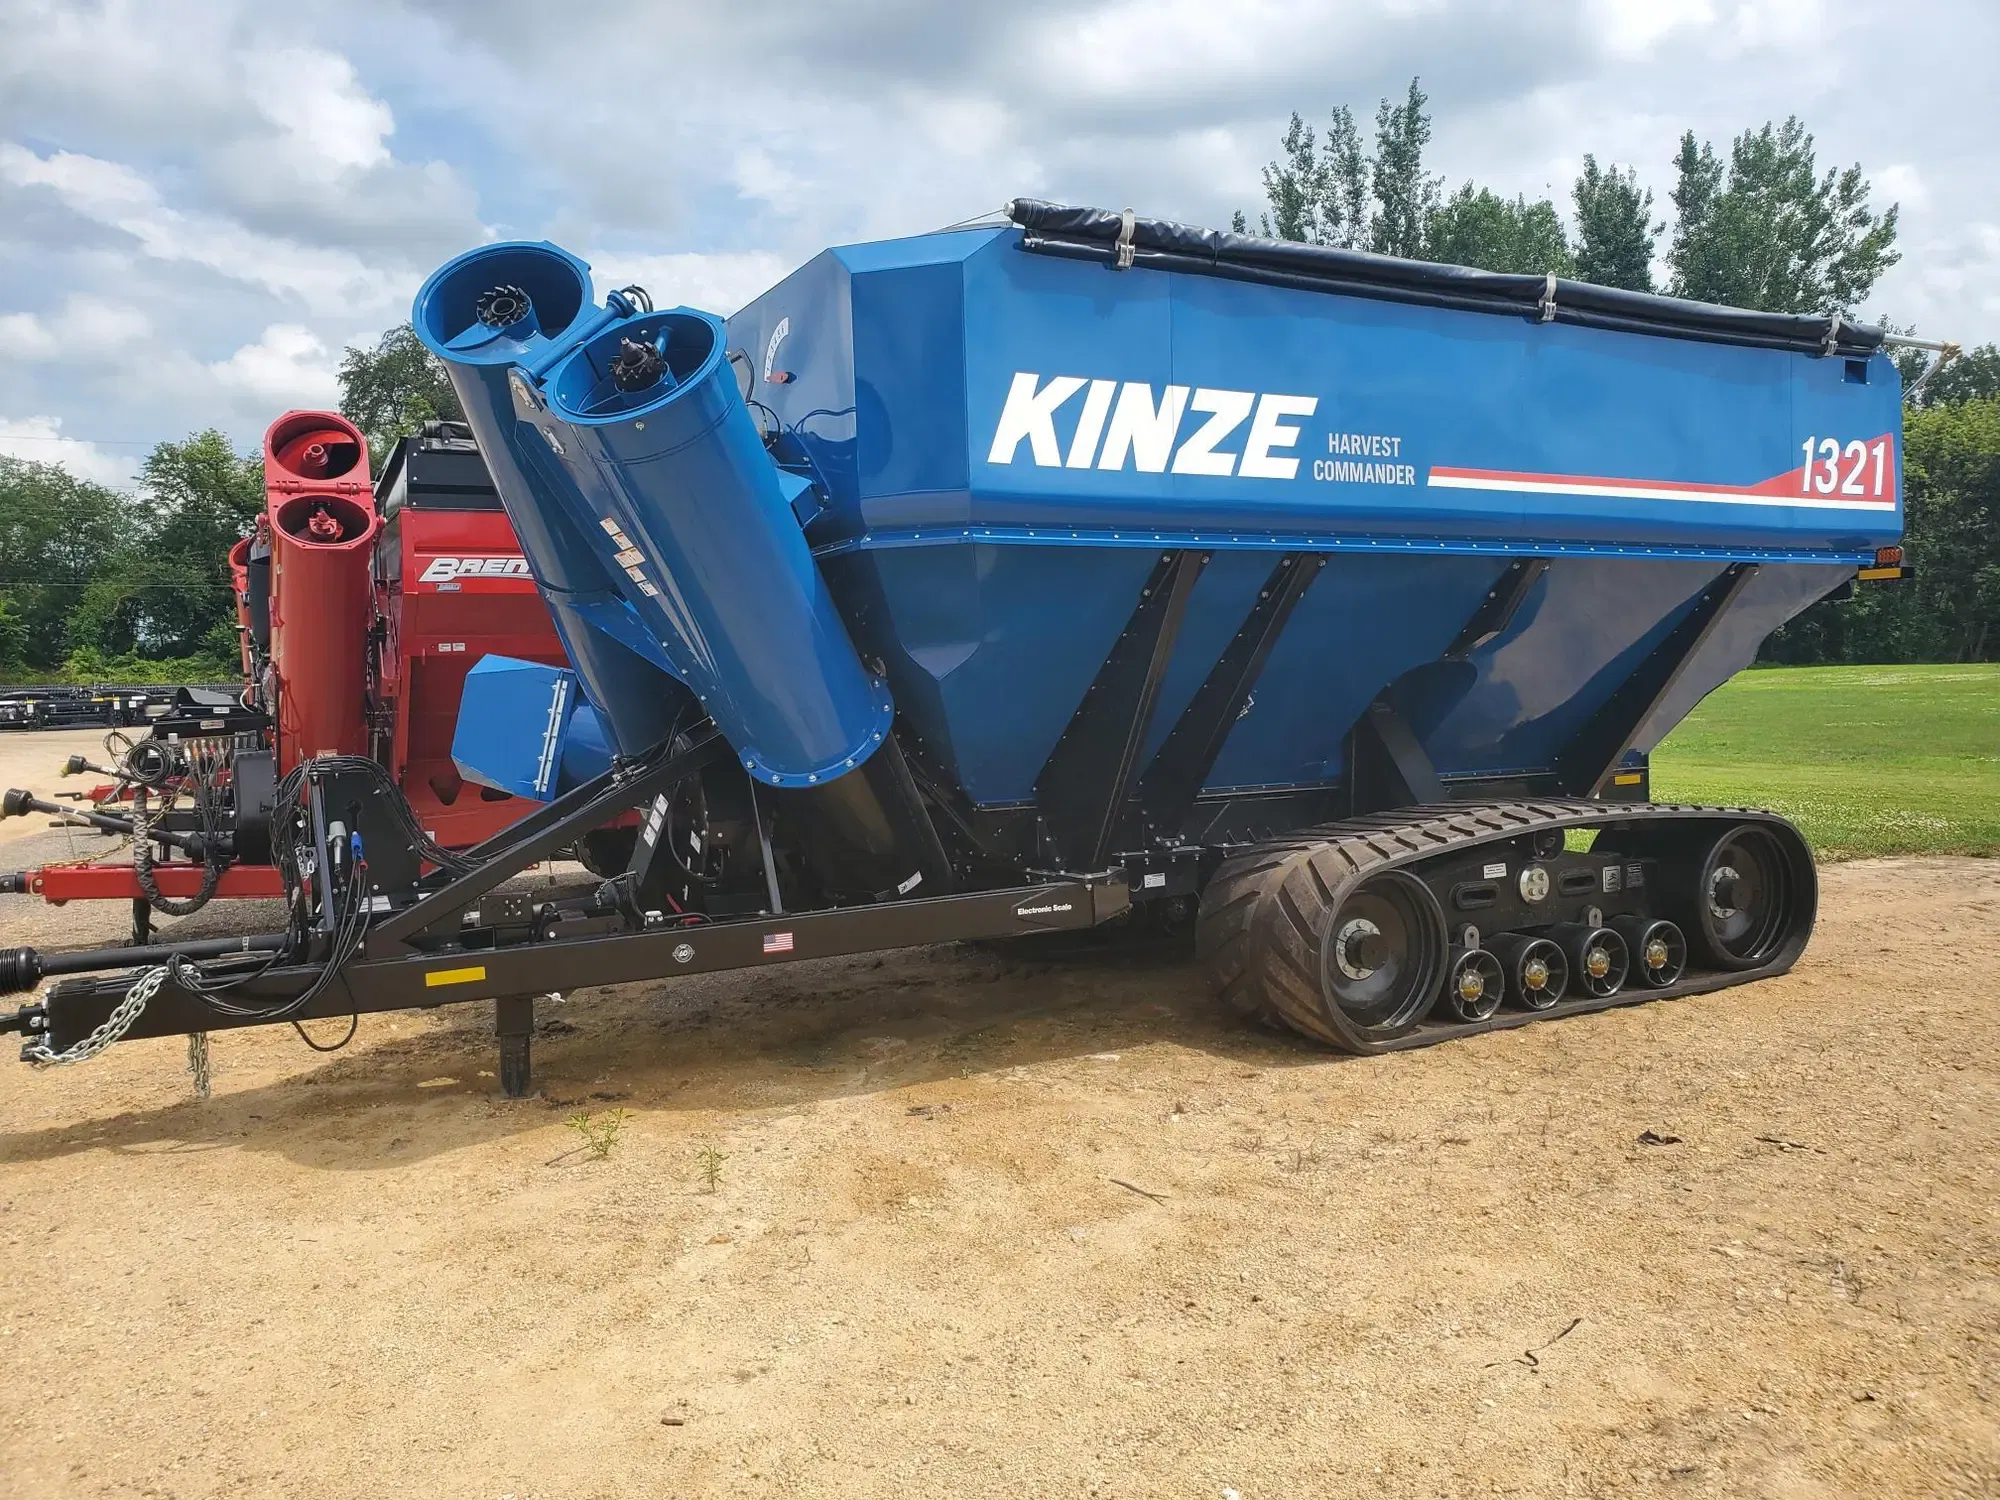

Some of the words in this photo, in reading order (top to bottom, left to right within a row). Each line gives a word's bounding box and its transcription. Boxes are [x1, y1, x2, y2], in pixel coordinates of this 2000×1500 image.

[987, 372, 1319, 479] KINZE
[1328, 432, 1401, 458] HARVEST
[1313, 459, 1416, 486] COMMANDER
[1802, 435, 1886, 496] 1321
[1017, 905, 1052, 915] Electronic
